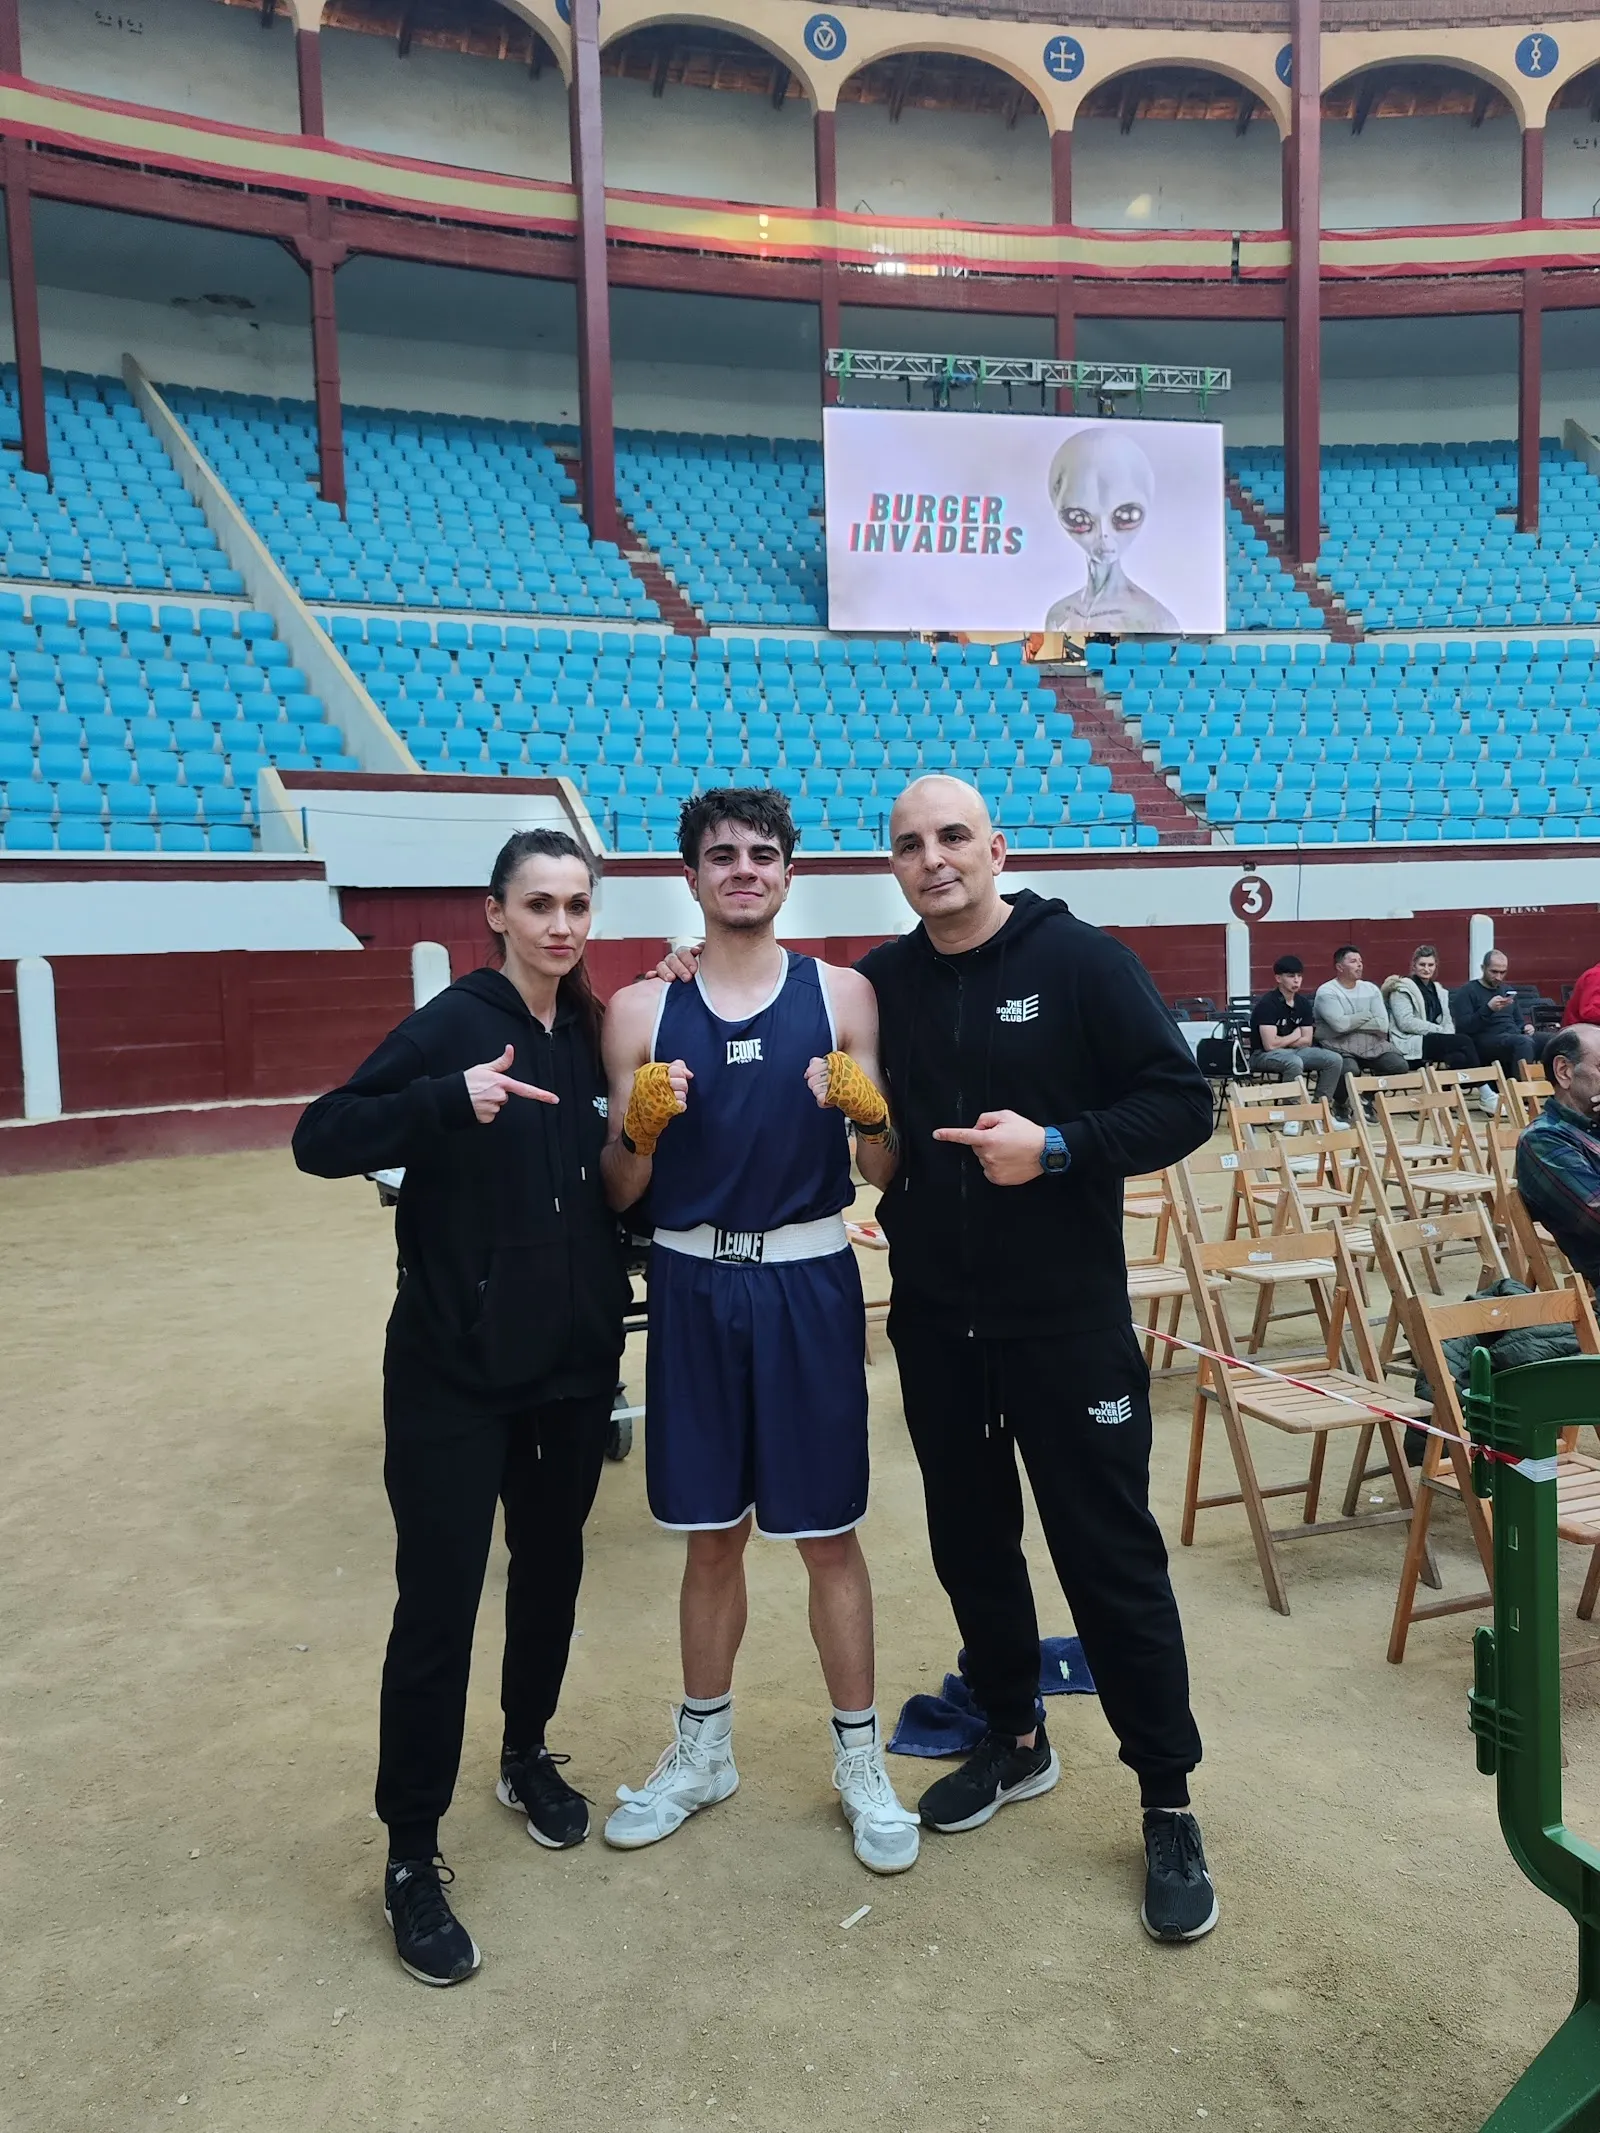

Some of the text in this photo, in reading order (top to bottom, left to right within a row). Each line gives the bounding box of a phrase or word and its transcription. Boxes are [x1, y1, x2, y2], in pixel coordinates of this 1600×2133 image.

[869, 493, 1004, 525] BURGER
[849, 523, 1024, 555] INVADERS
[1241, 880, 1263, 914] 3
[1005, 999, 1022, 1008] THE
[995, 1006, 1022, 1015] BOXER
[1000, 1014, 1022, 1023] CLUB
[726, 1038, 763, 1065] LEONE
[714, 1228, 763, 1263] LEONE
[1098, 1400, 1117, 1409] THE
[1087, 1406, 1118, 1417] BOXER
[1095, 1415, 1119, 1425] CLUB
